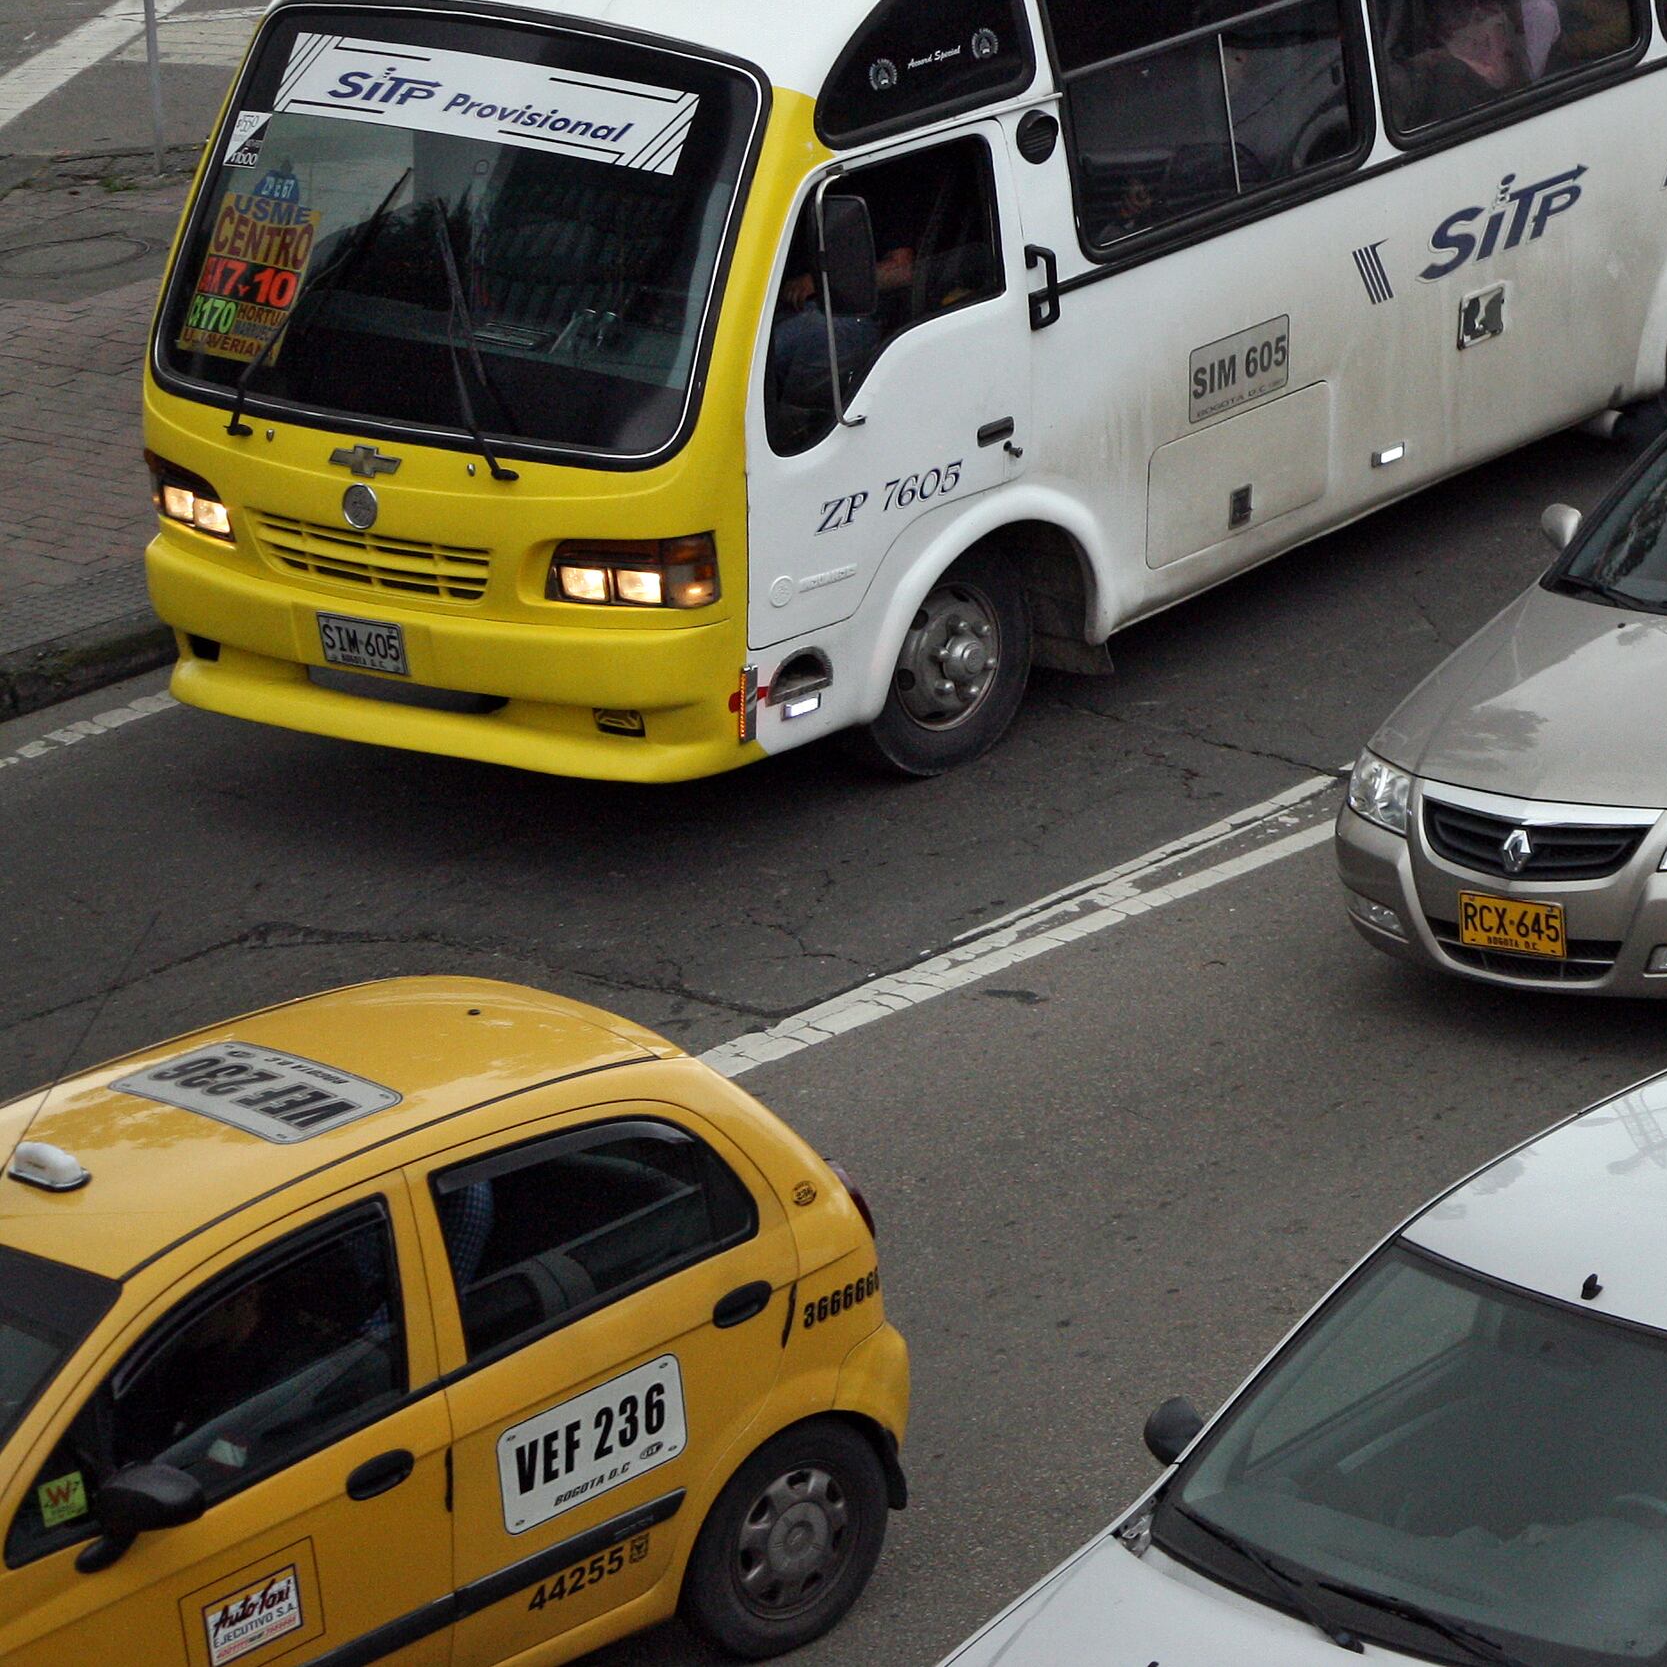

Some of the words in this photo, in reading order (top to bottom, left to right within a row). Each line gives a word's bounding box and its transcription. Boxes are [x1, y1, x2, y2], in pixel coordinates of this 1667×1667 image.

[442, 92, 635, 144] Provisional
[233, 194, 312, 226] USME
[212, 204, 314, 272] CENTRO
[252, 267, 298, 309] 10
[1192, 353, 1237, 400] SIM
[1245, 334, 1287, 379] 605
[814, 490, 869, 536] ZP
[882, 458, 964, 512] 7605
[150, 1056, 286, 1096] 236
[234, 1083, 360, 1129] VEF
[514, 1418, 581, 1496] VEF
[593, 1381, 666, 1462] 236
[553, 1475, 606, 1508] BOGOTA
[528, 1545, 624, 1613] 44255
[213, 1594, 259, 1638] Auto
[259, 1577, 292, 1614] Taxi
[213, 1612, 273, 1649] EJECUTIVO
